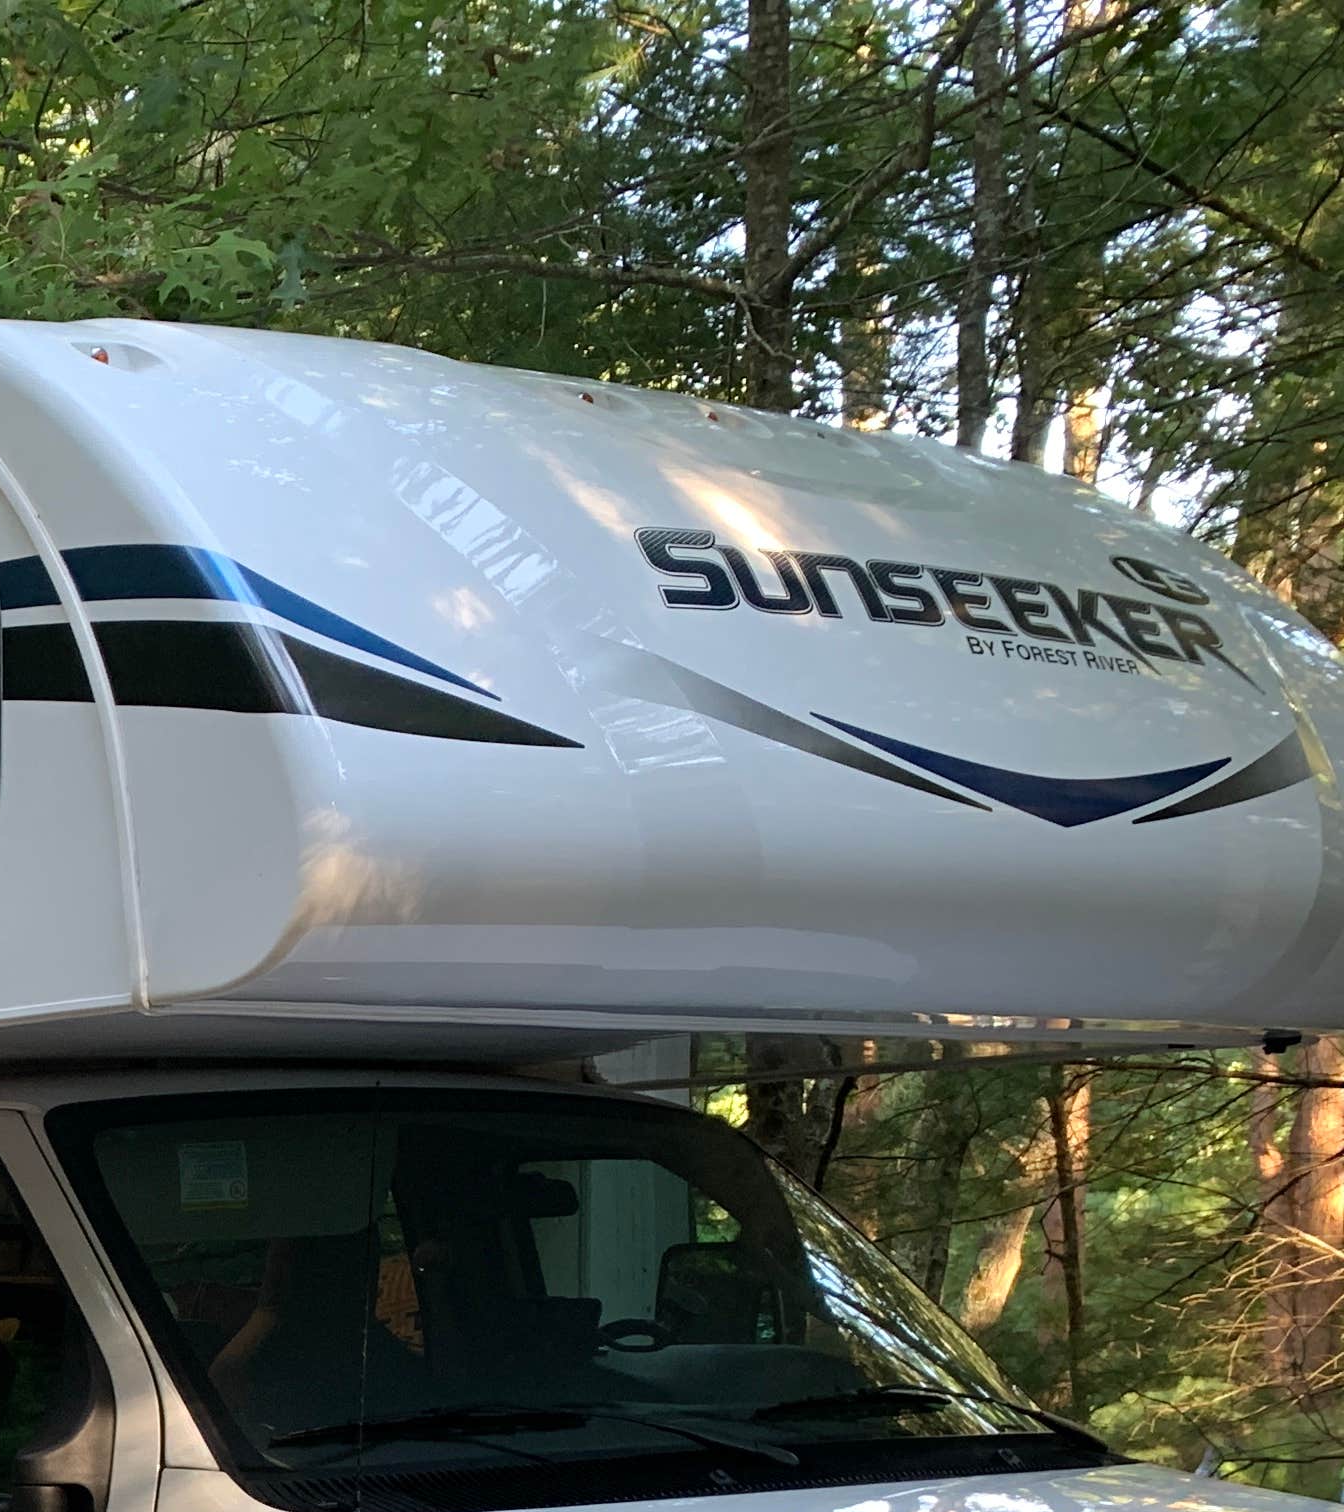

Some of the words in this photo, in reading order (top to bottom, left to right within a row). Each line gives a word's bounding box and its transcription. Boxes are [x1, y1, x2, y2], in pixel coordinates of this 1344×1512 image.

[633, 526, 1266, 696] SUNSEEKER
[1001, 639, 1079, 668] FOREST
[1083, 650, 1142, 676] RIVER
